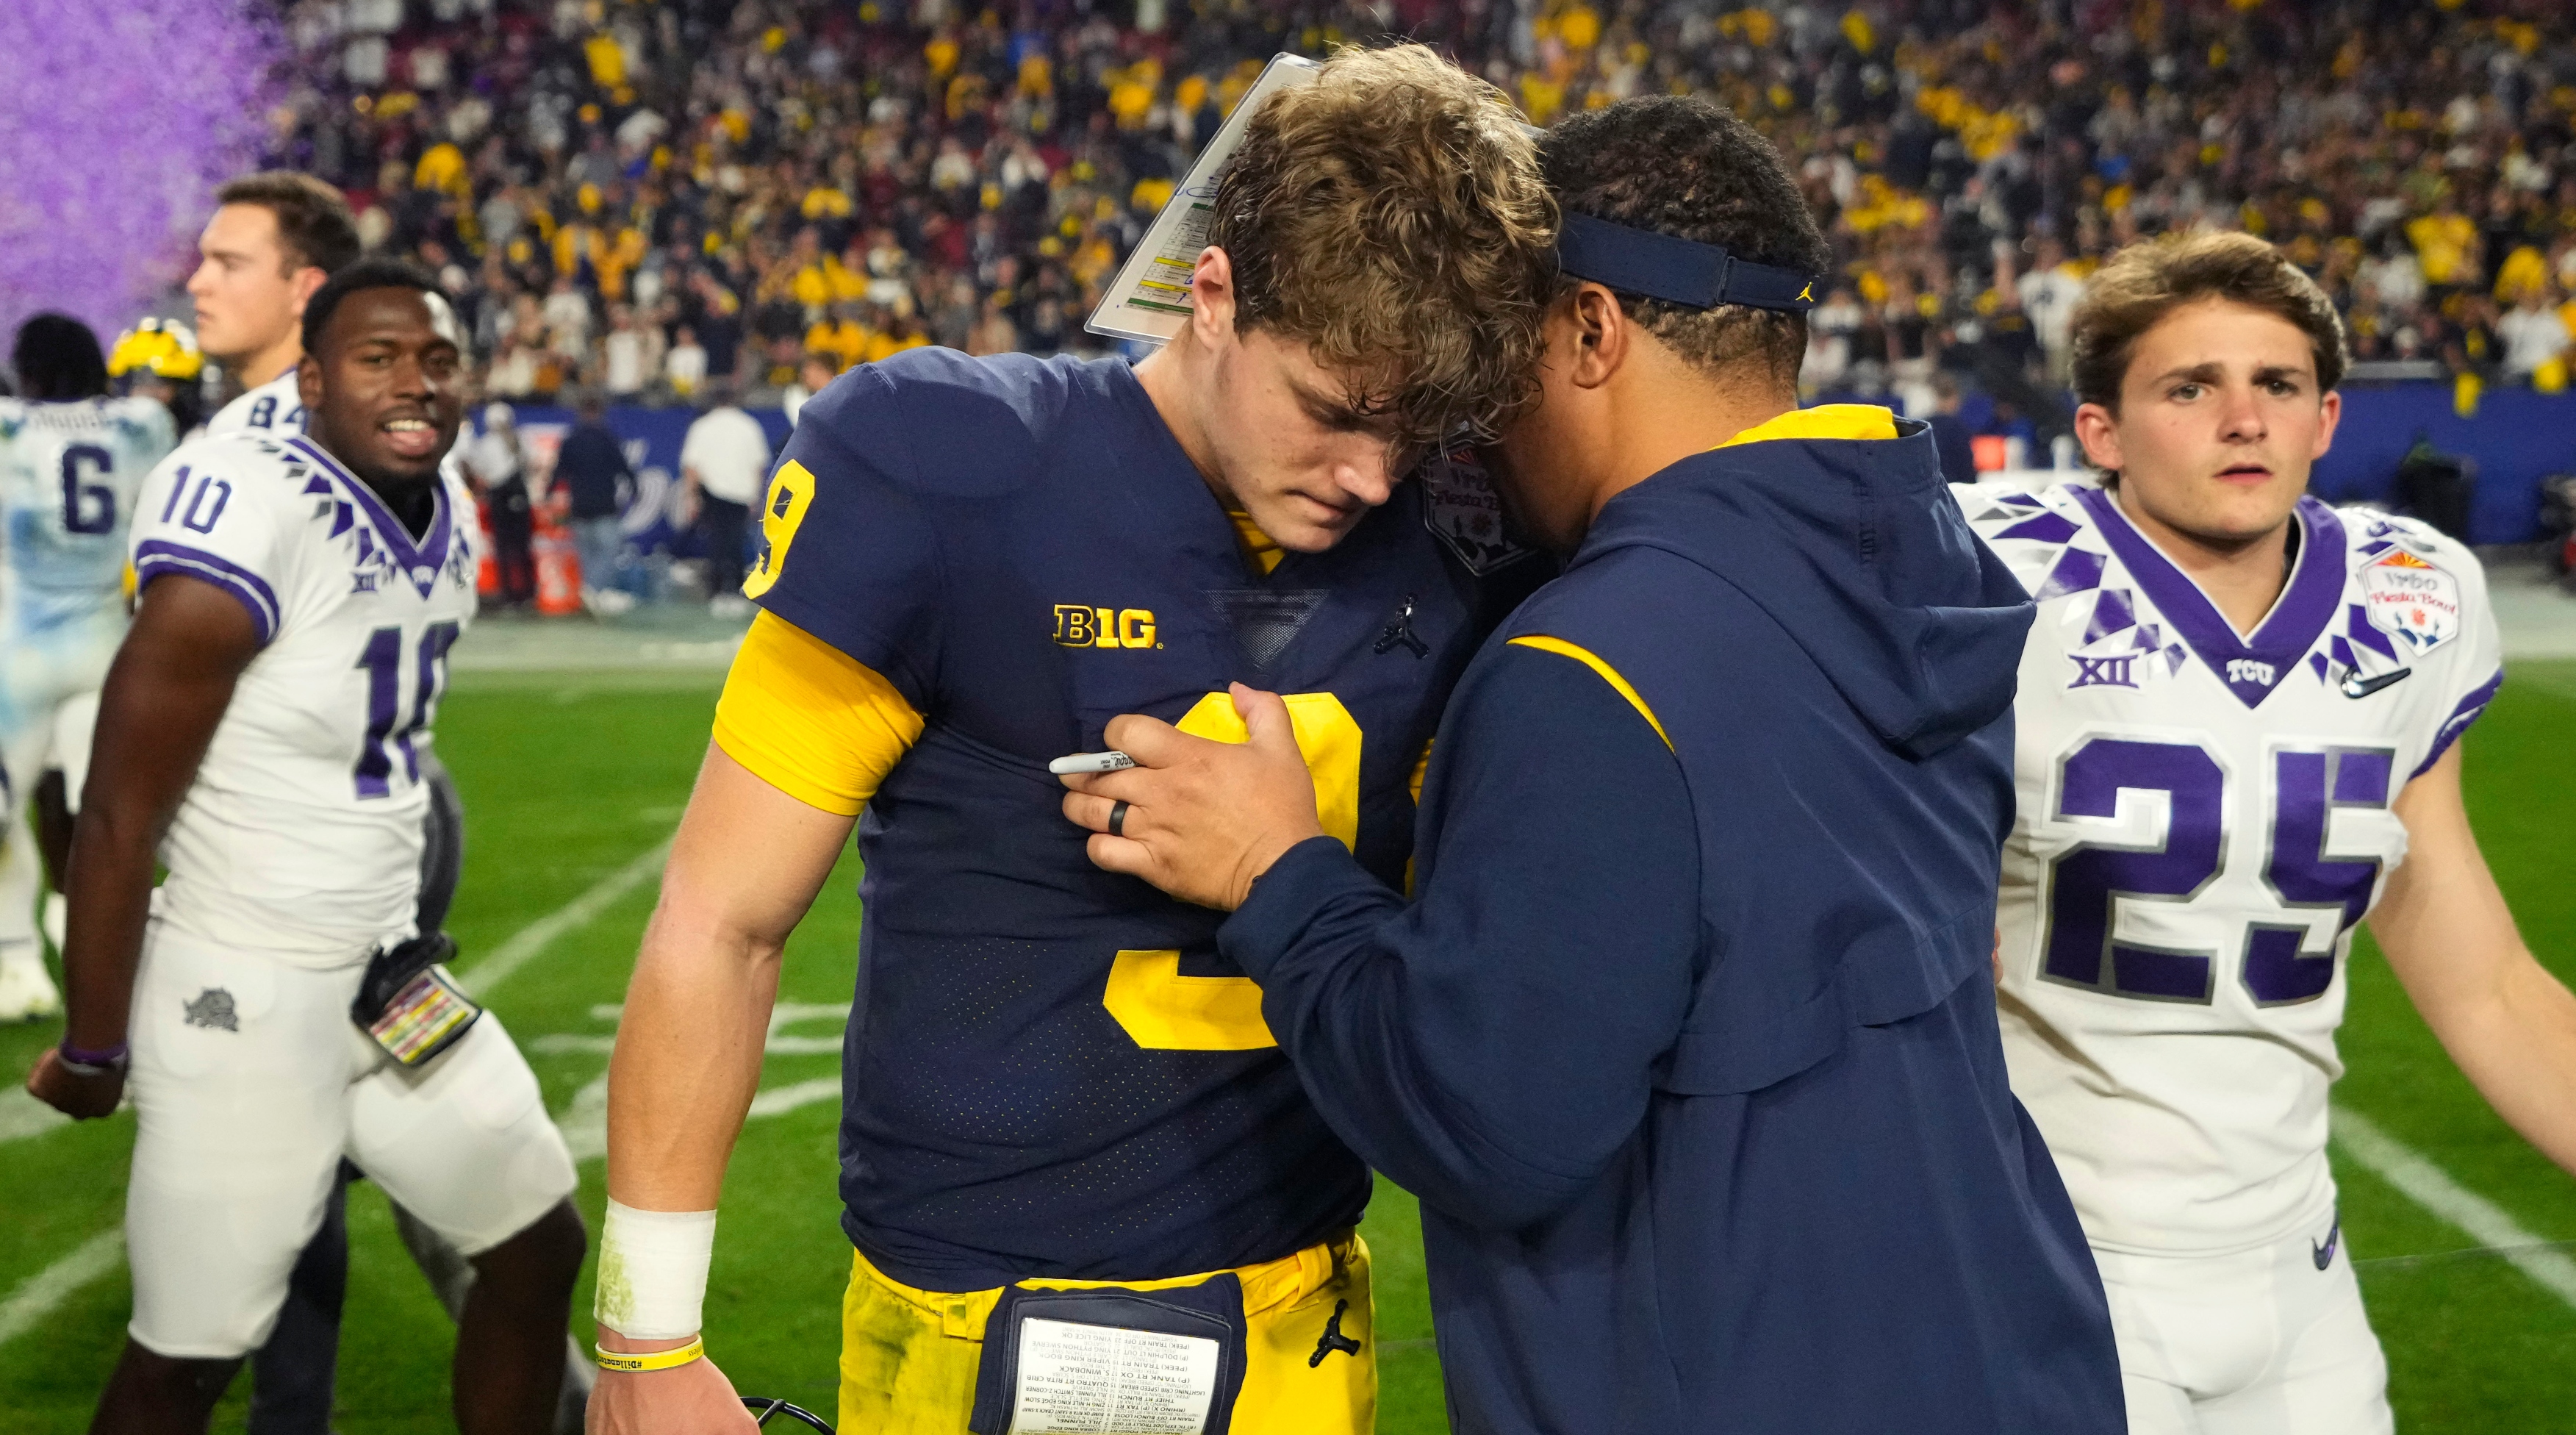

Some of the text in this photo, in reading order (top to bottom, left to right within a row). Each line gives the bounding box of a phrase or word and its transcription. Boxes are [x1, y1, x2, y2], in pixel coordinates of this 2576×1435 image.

[62, 443, 115, 534] 6
[161, 465, 232, 534] 10
[741, 459, 815, 599] 9
[2384, 572, 2438, 590] Vrbo
[2369, 591, 2456, 615] Fiesta Bowl
[2067, 654, 2139, 690] XII
[2225, 659, 2275, 687] TCU
[2036, 737, 2395, 1009] 25
[1060, 1366, 1101, 1375] WINDBACK
